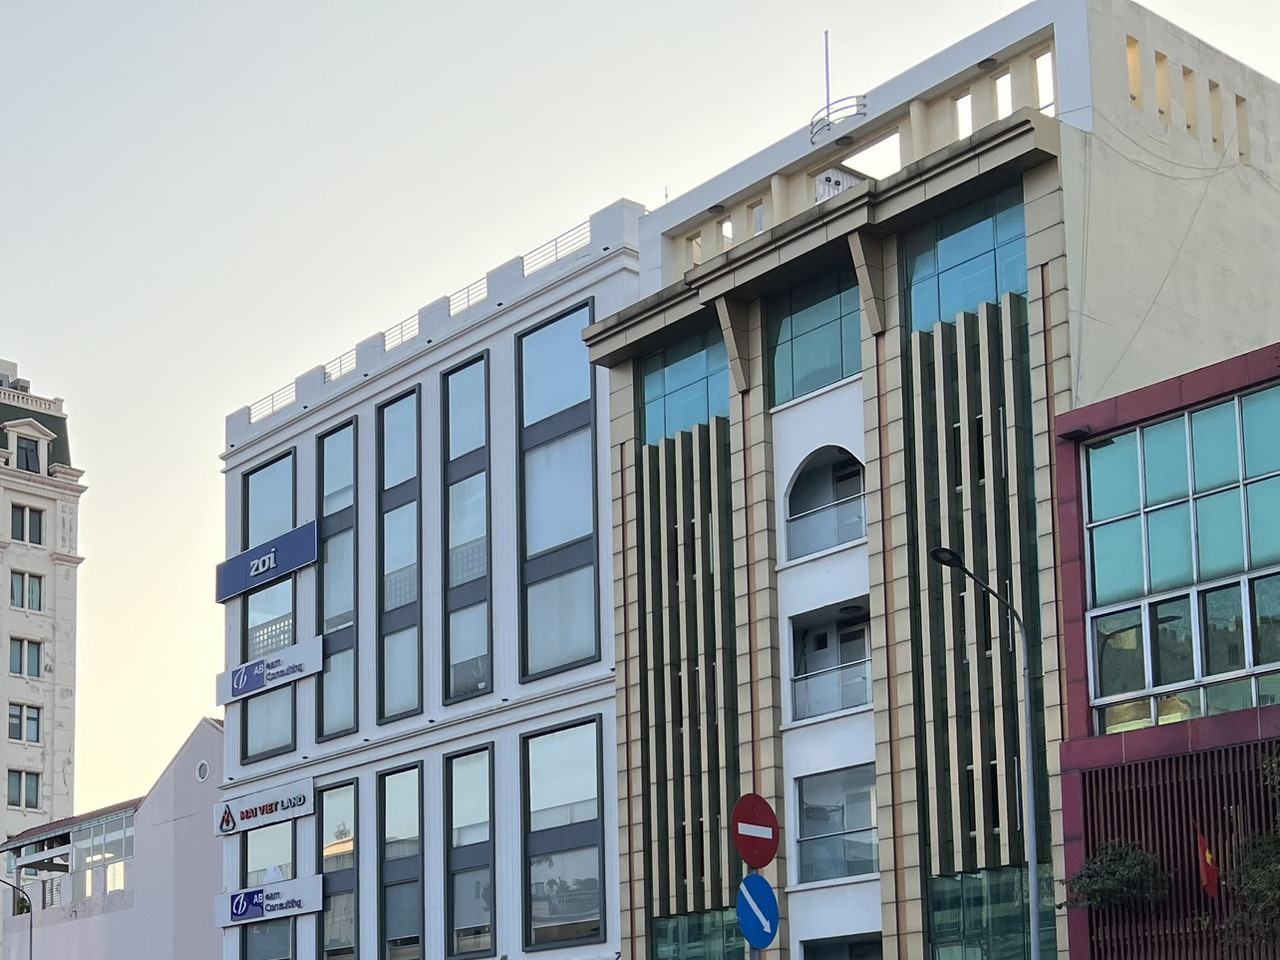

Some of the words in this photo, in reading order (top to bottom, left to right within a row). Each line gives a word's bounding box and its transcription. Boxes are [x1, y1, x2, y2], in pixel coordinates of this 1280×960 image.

[266, 663, 304, 681] Consulting
[240, 809, 257, 821] MAI
[258, 801, 279, 816] VIET
[280, 794, 306, 810] LAND
[265, 898, 303, 912] Consulting
